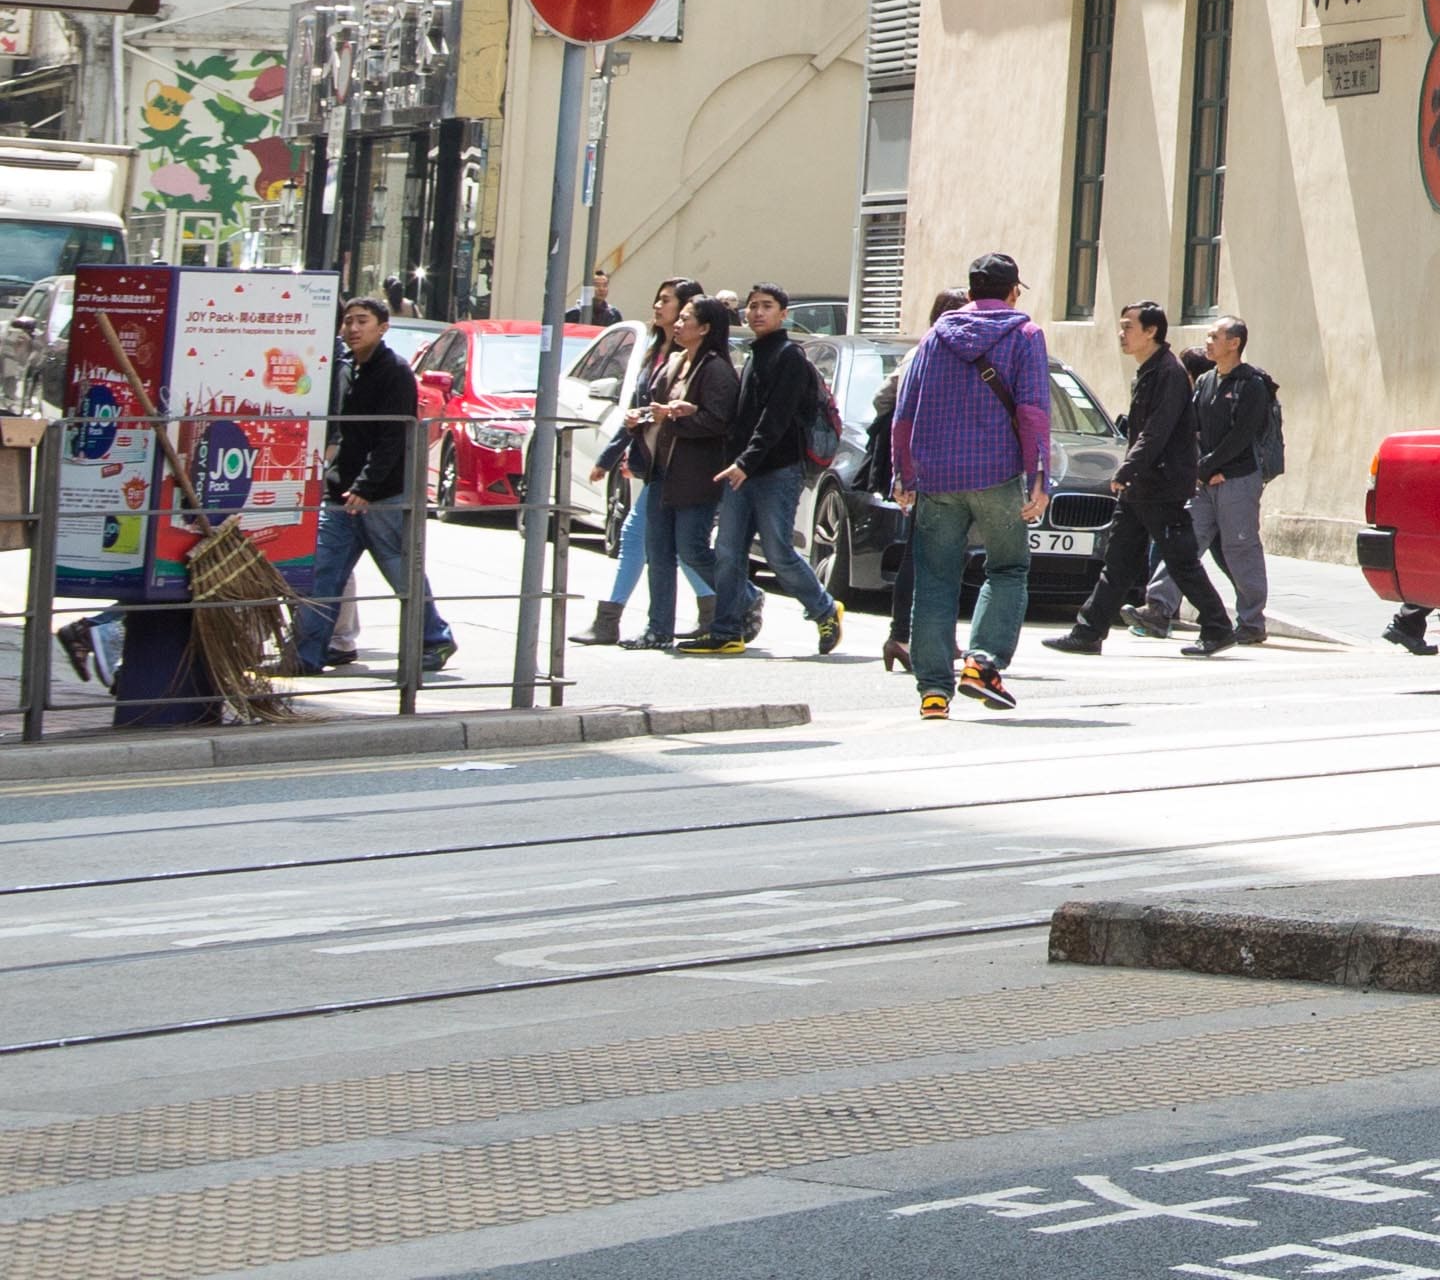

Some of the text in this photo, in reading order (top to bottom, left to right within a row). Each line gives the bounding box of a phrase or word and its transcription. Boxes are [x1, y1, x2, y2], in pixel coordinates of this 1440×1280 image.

[185, 312, 206, 323] JOY
[209, 447, 259, 480] JOY
[208, 481, 230, 492] Pack
[1048, 534, 1074, 551] 70
